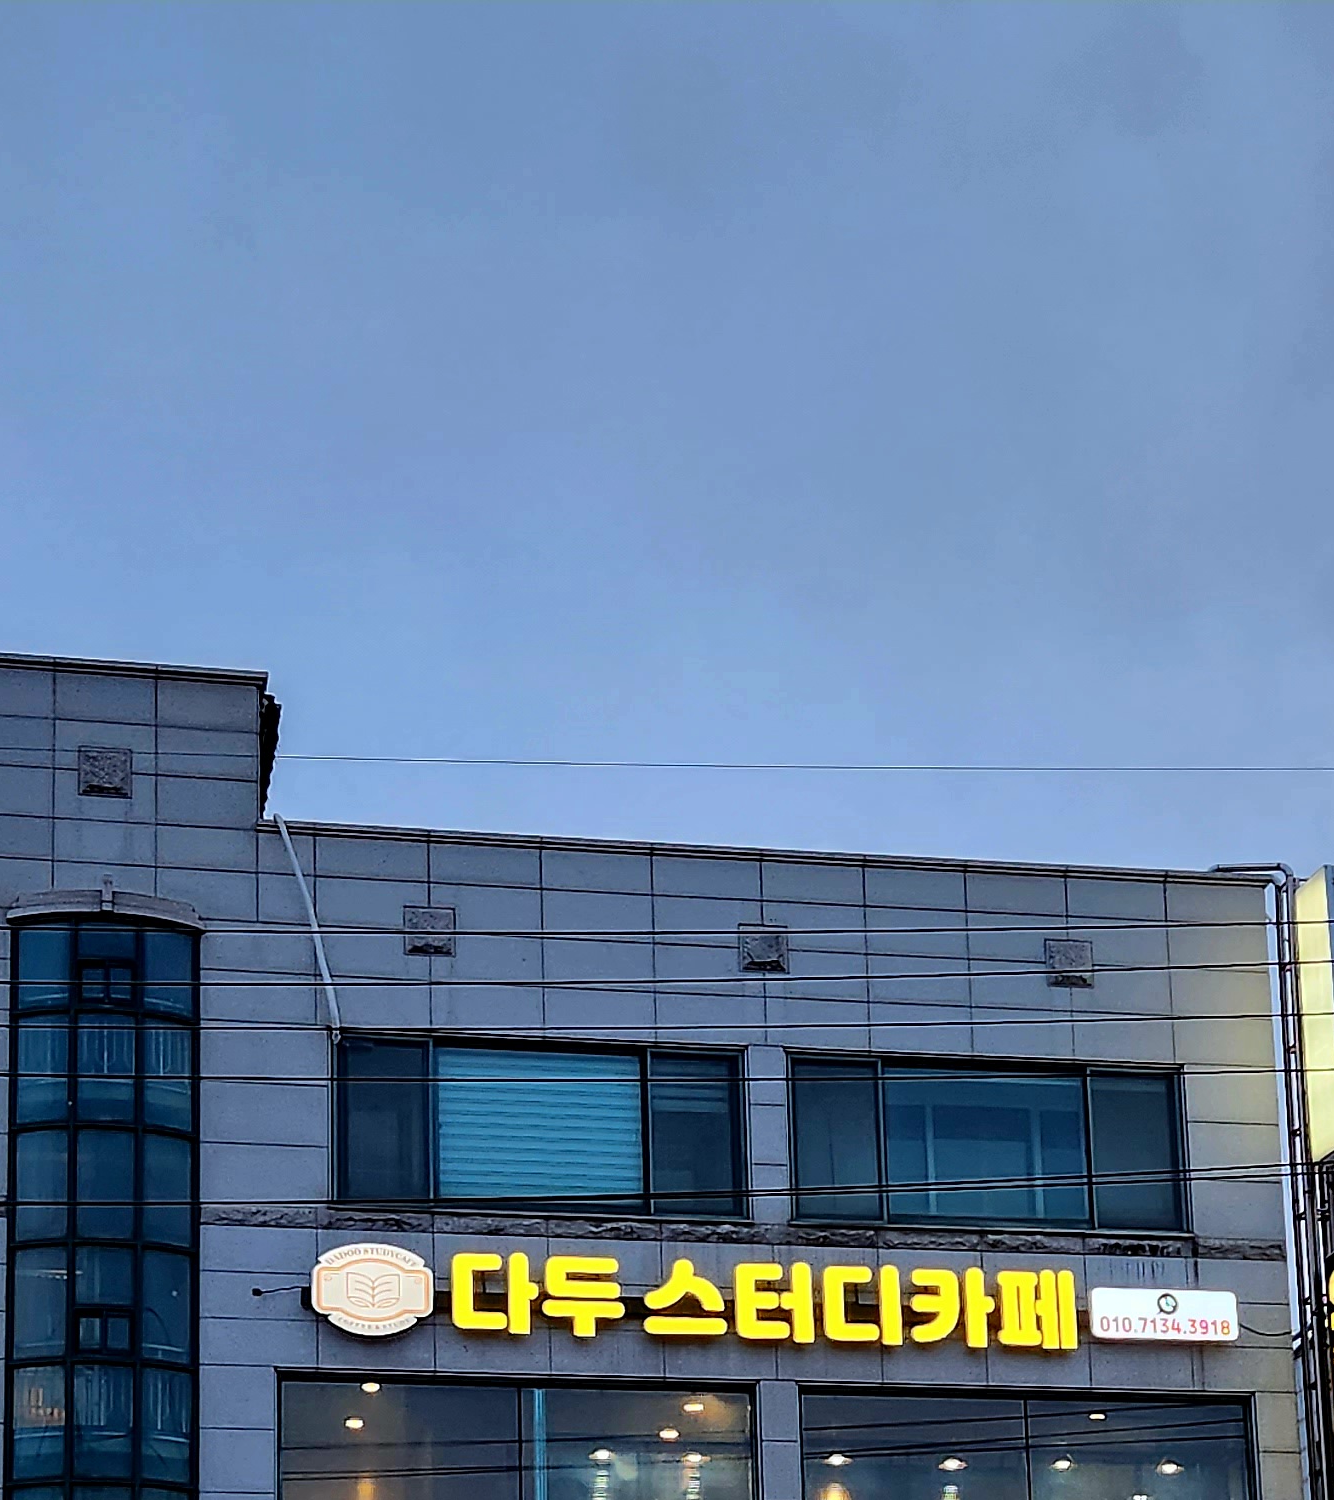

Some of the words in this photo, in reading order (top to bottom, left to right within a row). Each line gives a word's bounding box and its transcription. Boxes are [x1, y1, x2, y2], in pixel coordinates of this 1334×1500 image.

[449, 1251, 627, 1339] 다두
[643, 1257, 1077, 1350] 스터디카페
[1100, 1315, 1230, 1336] 010.7134.3918
